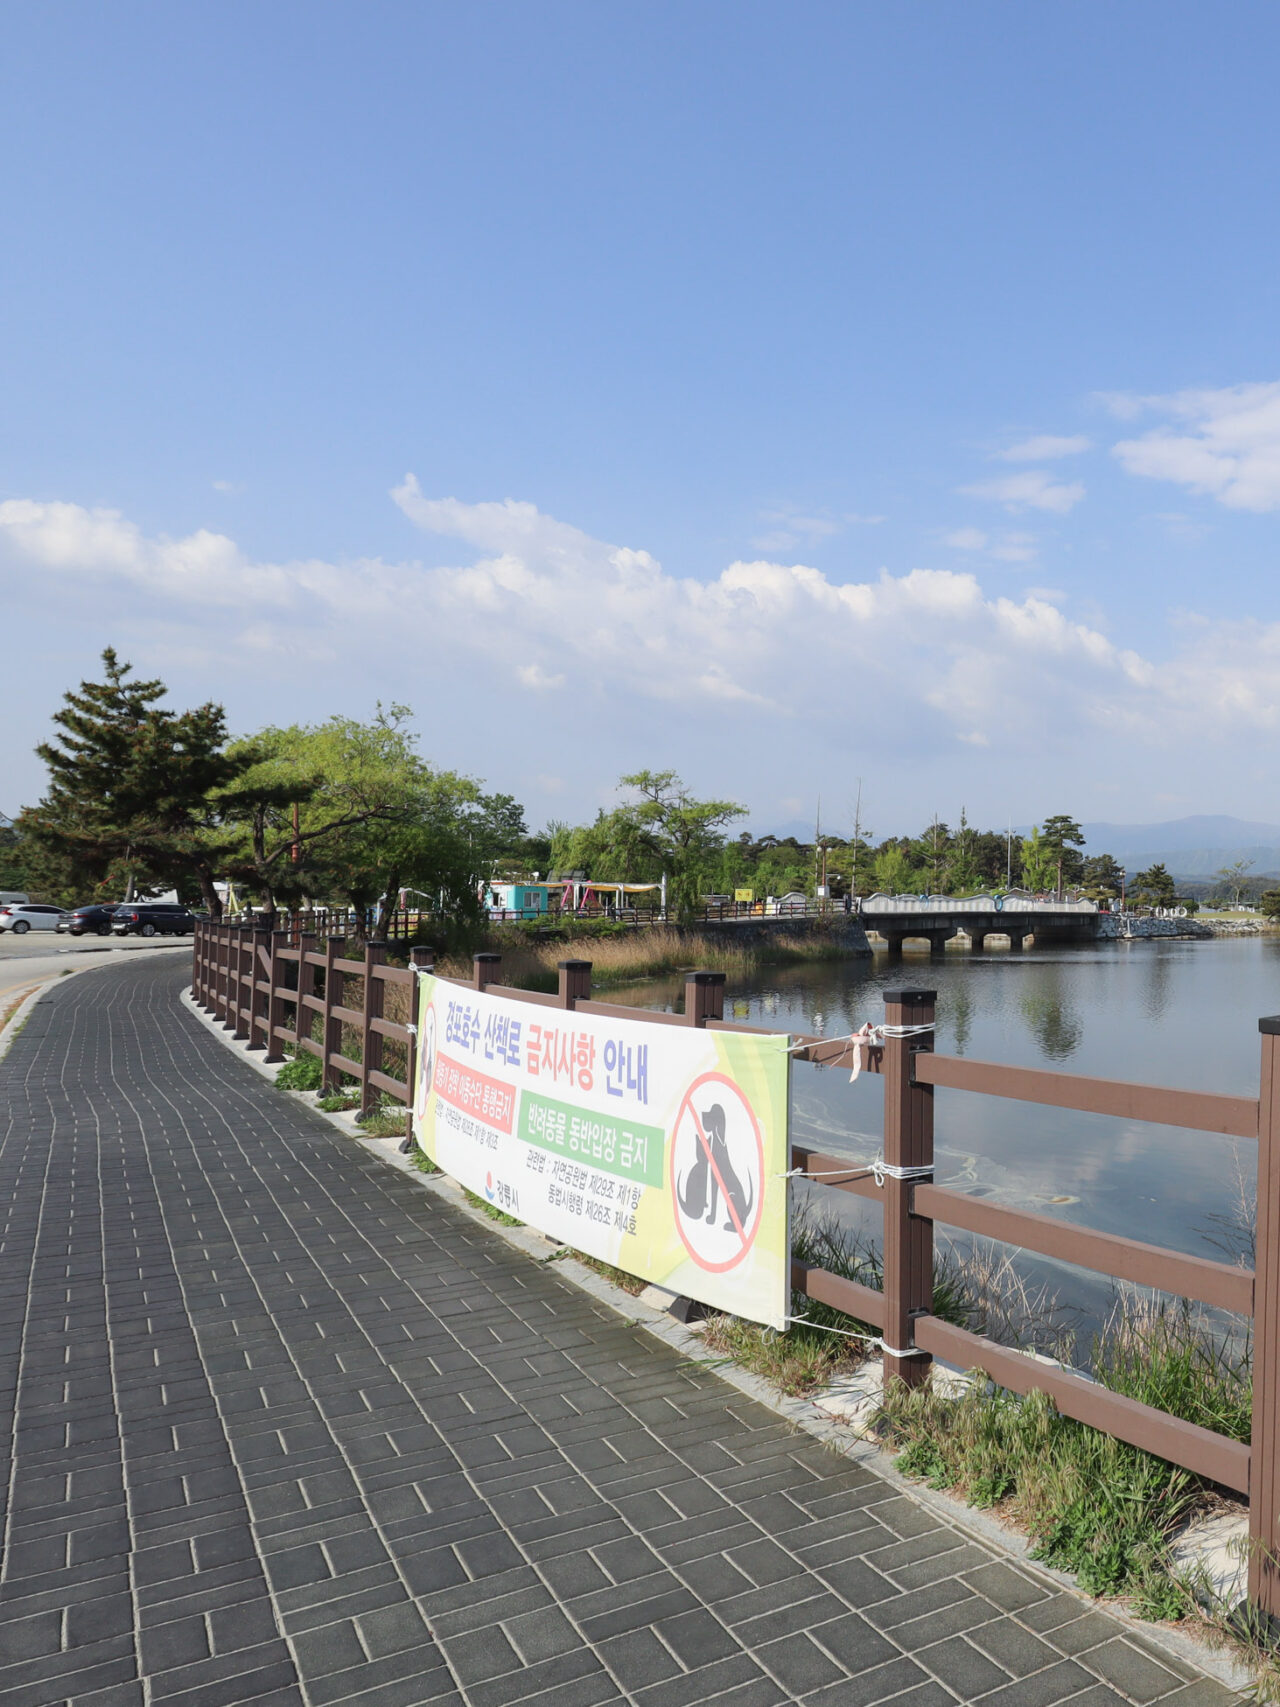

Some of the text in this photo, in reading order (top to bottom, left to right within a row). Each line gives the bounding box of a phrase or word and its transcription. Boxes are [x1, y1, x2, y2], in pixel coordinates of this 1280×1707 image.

[446, 1001, 648, 1105] 경포호수 산책로 금지사항 안내
[459, 1075, 483, 1110] 이동수단
[482, 1084, 512, 1126] 통행금지
[528, 1103, 648, 1174] 반려동물 동반입장 금지
[497, 1180, 520, 1213] 강릉시
[526, 1149, 546, 1174] 관련법
[551, 1160, 588, 1190] 자연공원법
[588, 1174, 615, 1199] 제29조
[616, 1184, 642, 1210] 제1항
[548, 1183, 637, 1236] 동법시행령 제26조 제4호
